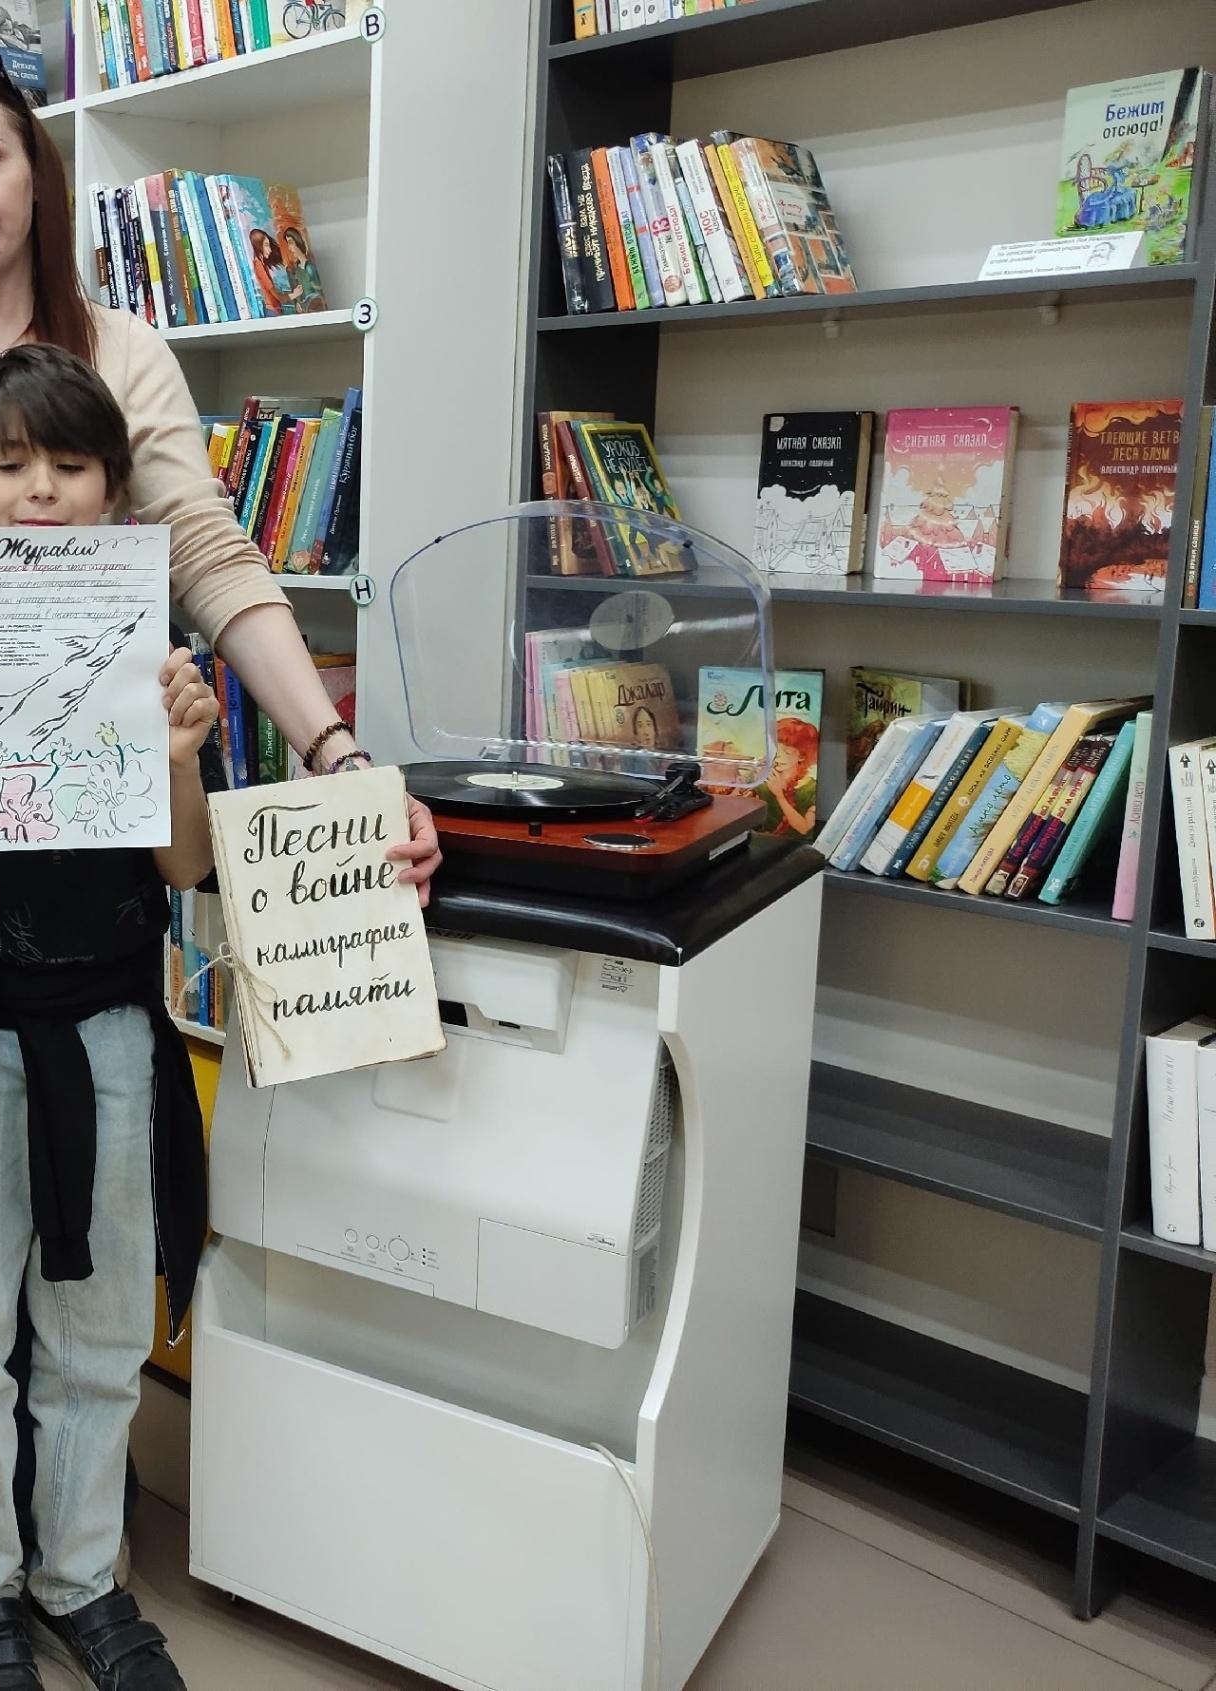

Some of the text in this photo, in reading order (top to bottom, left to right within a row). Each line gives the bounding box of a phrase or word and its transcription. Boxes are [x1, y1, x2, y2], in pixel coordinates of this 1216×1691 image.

[366, 13, 381, 36] В
[1105, 100, 1165, 122] Бежим
[1102, 115, 1165, 139] отсюда!
[652, 217, 671, 238] 13
[699, 211, 713, 236] МОС
[600, 439, 641, 457] УРОКОВ
[776, 436, 842, 450] МЯТНАЯ СКАЗКА
[904, 432, 987, 448] СНЕЖНАЯ СКАЗКА
[1100, 429, 1181, 446] ТЛЕЮЩИЕ ВЕТВ
[603, 455, 648, 474] НЕ БУДЕТ
[1112, 446, 1170, 461] ЛЕСА БЛУМ
[1101, 463, 1179, 476] АЛЕКСАНДР ПОЛЯРНЫЙ
[355, 579, 372, 601] Н
[614, 682, 665, 709] Джалар
[855, 682, 912, 718] Тайрин
[993, 773, 1013, 802] лето
[244, 802, 388, 864] Песни
[252, 854, 398, 913] о войне
[273, 973, 417, 1022] памяти
